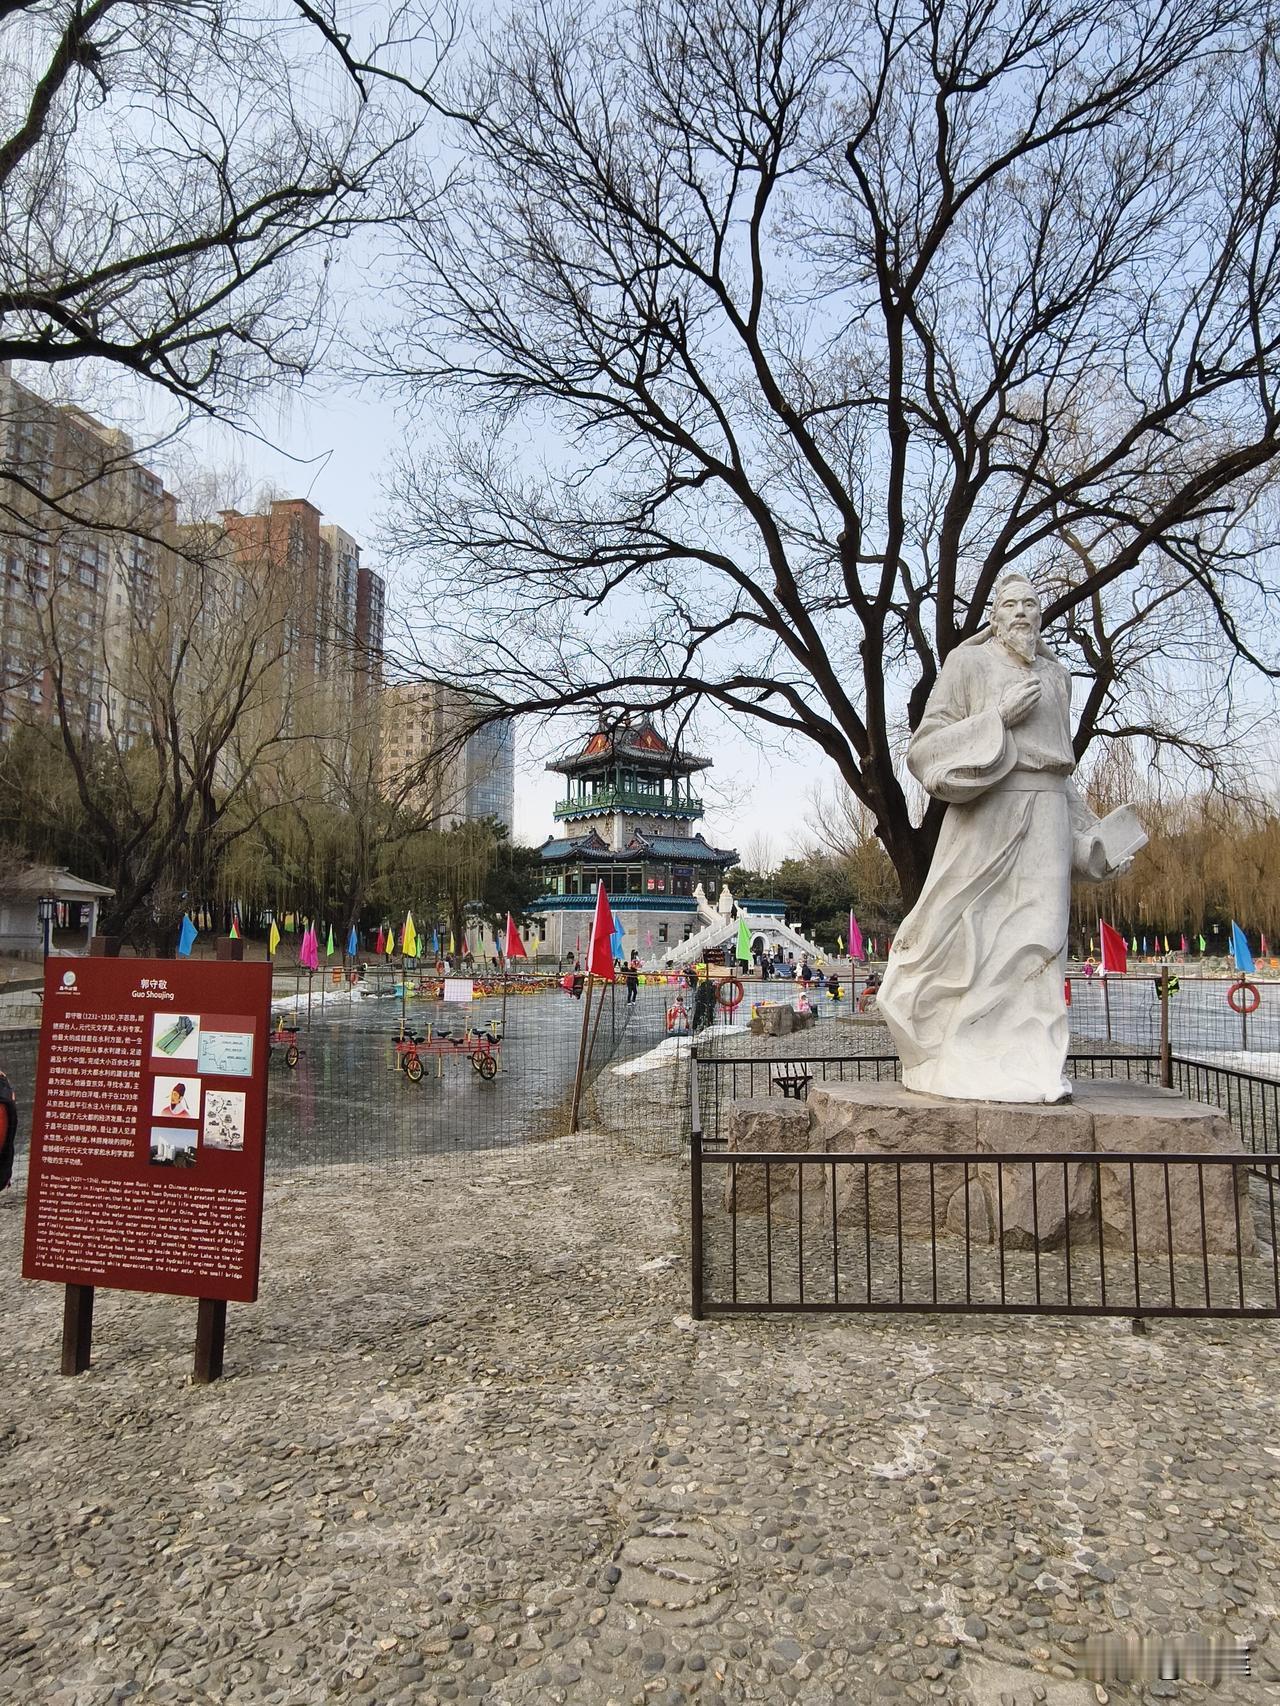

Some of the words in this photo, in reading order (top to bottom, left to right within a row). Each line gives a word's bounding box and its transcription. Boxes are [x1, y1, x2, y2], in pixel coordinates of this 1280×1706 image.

[141, 978, 167, 990] 郭守敬
[131, 990, 145, 999] Guo
[146, 990, 175, 1000] Shoujing
